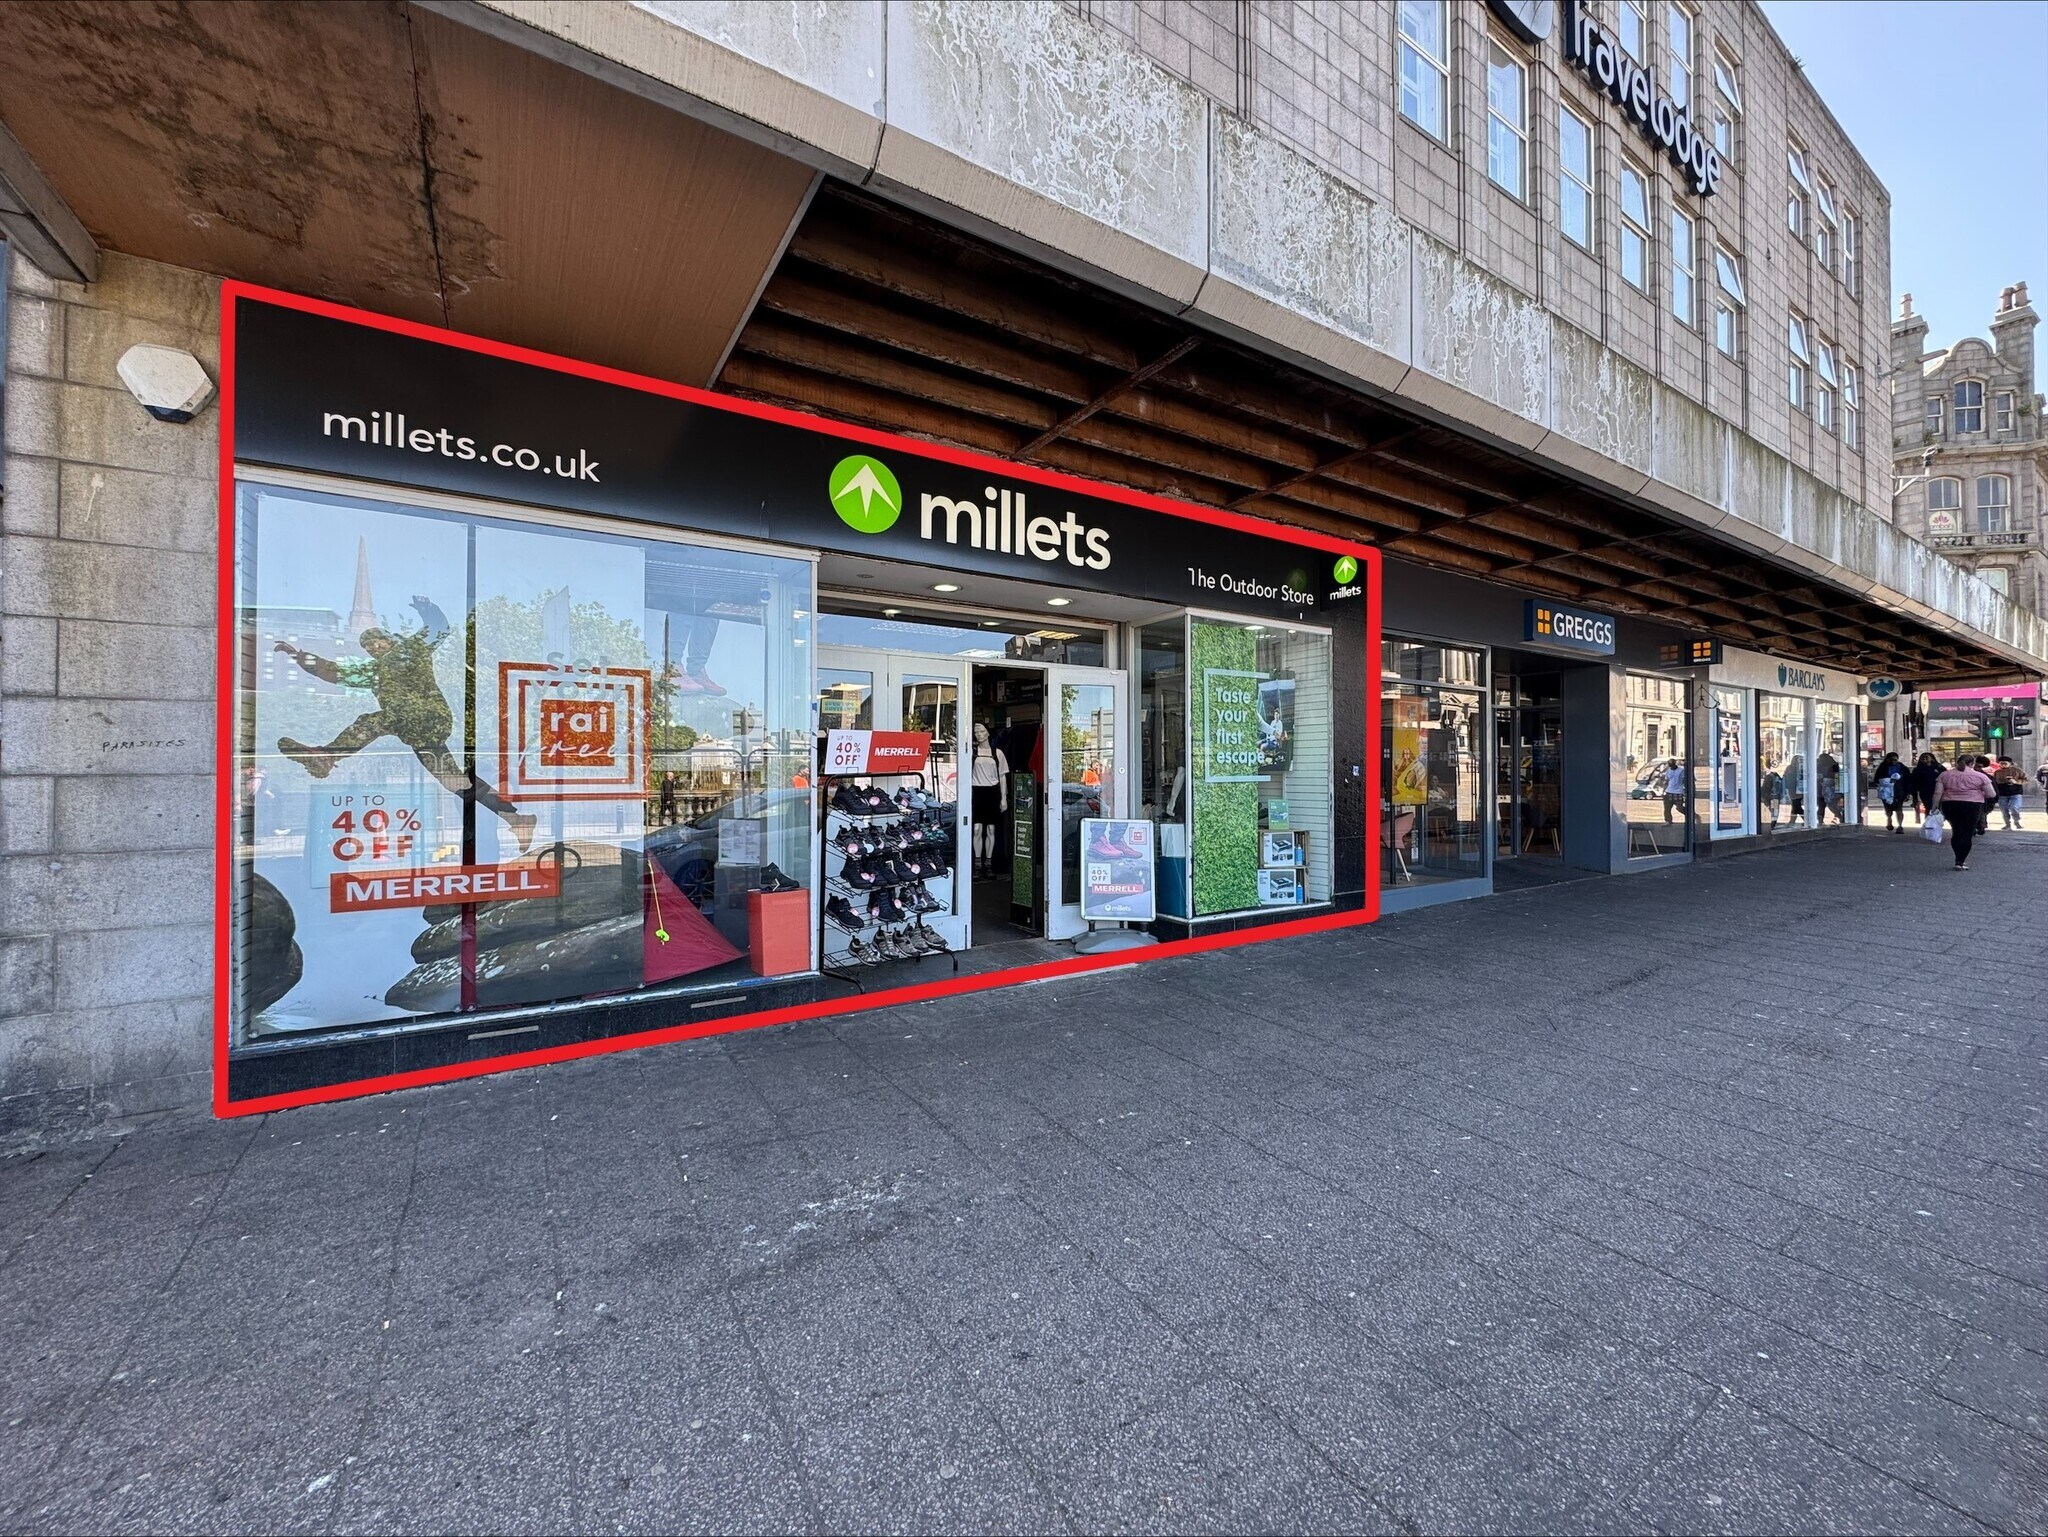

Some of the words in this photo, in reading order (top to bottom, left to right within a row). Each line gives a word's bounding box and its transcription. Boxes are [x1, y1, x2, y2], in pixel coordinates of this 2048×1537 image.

[322, 411, 600, 482] millets.co.uk
[920, 486, 1112, 570] millets
[1188, 567, 1216, 589] The
[1220, 573, 1278, 600] Outdoor
[1281, 584, 1314, 606] Store
[1329, 585, 1362, 601] millets
[1553, 612, 1612, 646] GREGGS
[1788, 667, 1825, 692] BARCLAYS
[1215, 687, 1251, 704] Taste
[1215, 708, 1248, 726] your
[1215, 728, 1243, 745] first
[836, 742, 861, 753] 40%
[874, 747, 922, 757] MERRELL
[1216, 751, 1265, 766] escape
[331, 796, 354, 807] UP
[362, 795, 385, 806] TO
[332, 808, 422, 834] 40%
[332, 834, 414, 862] OFF
